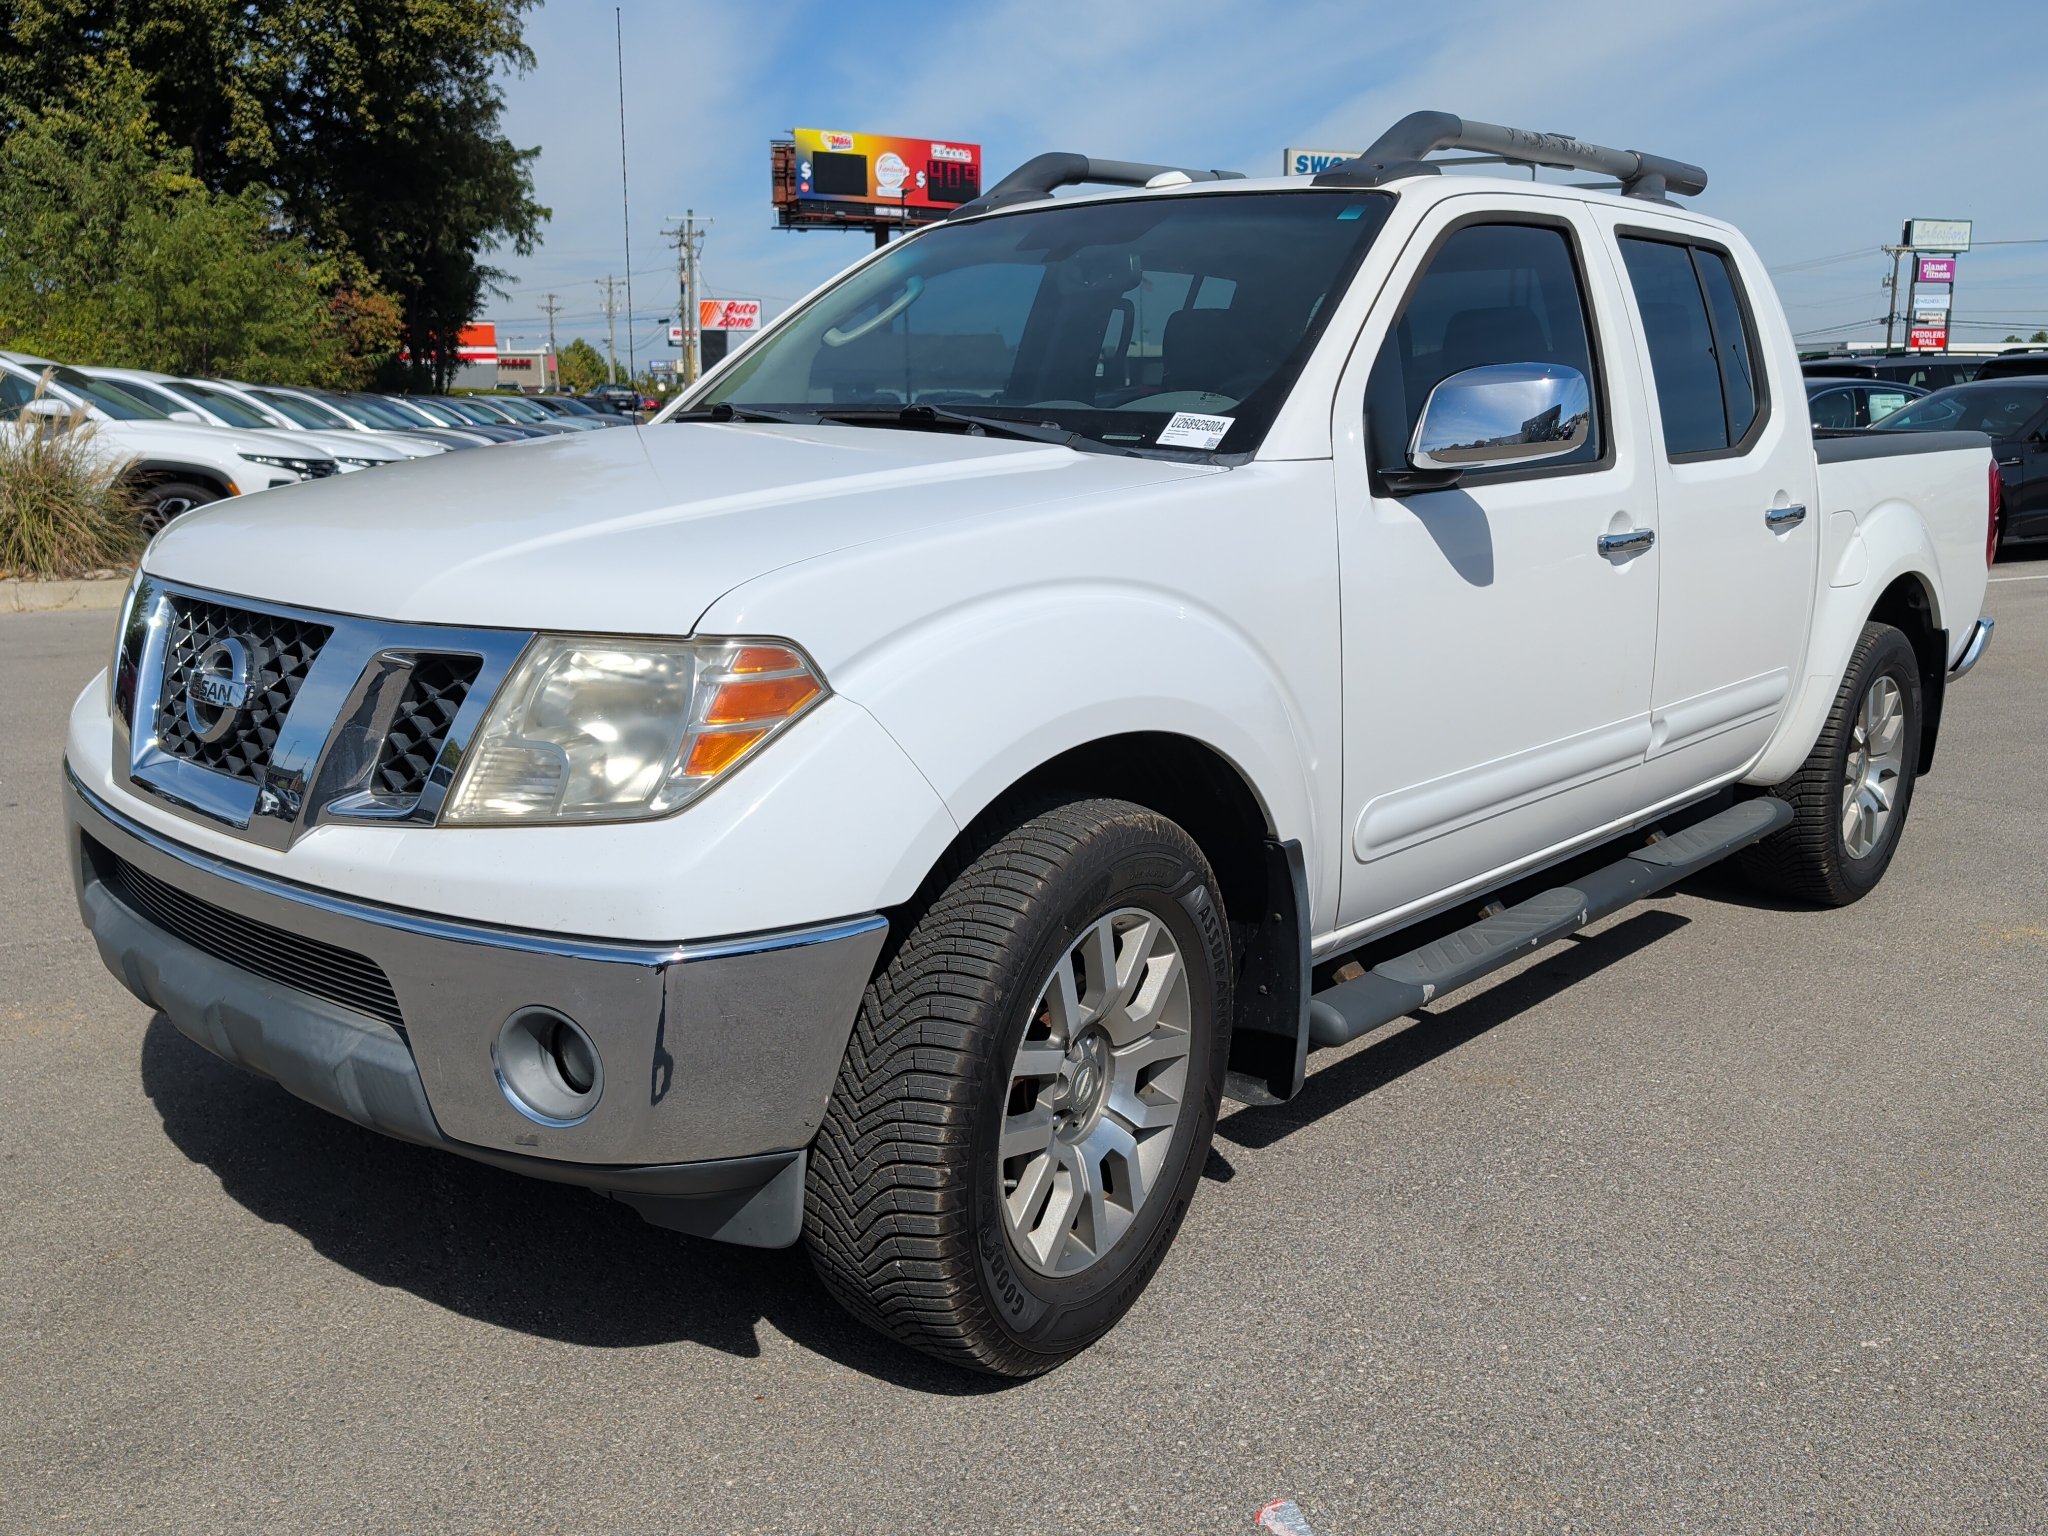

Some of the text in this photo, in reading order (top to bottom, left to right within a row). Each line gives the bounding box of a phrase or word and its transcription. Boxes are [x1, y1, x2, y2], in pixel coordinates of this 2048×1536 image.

[1924, 262, 1947, 272] planet
[1926, 271, 1950, 279] fitness
[725, 302, 757, 314] Auto
[718, 317, 753, 327] Zone
[1912, 330, 1945, 339] PEDDLERS
[1918, 338, 1936, 346] MALL
[1172, 417, 1226, 432] U26892500A
